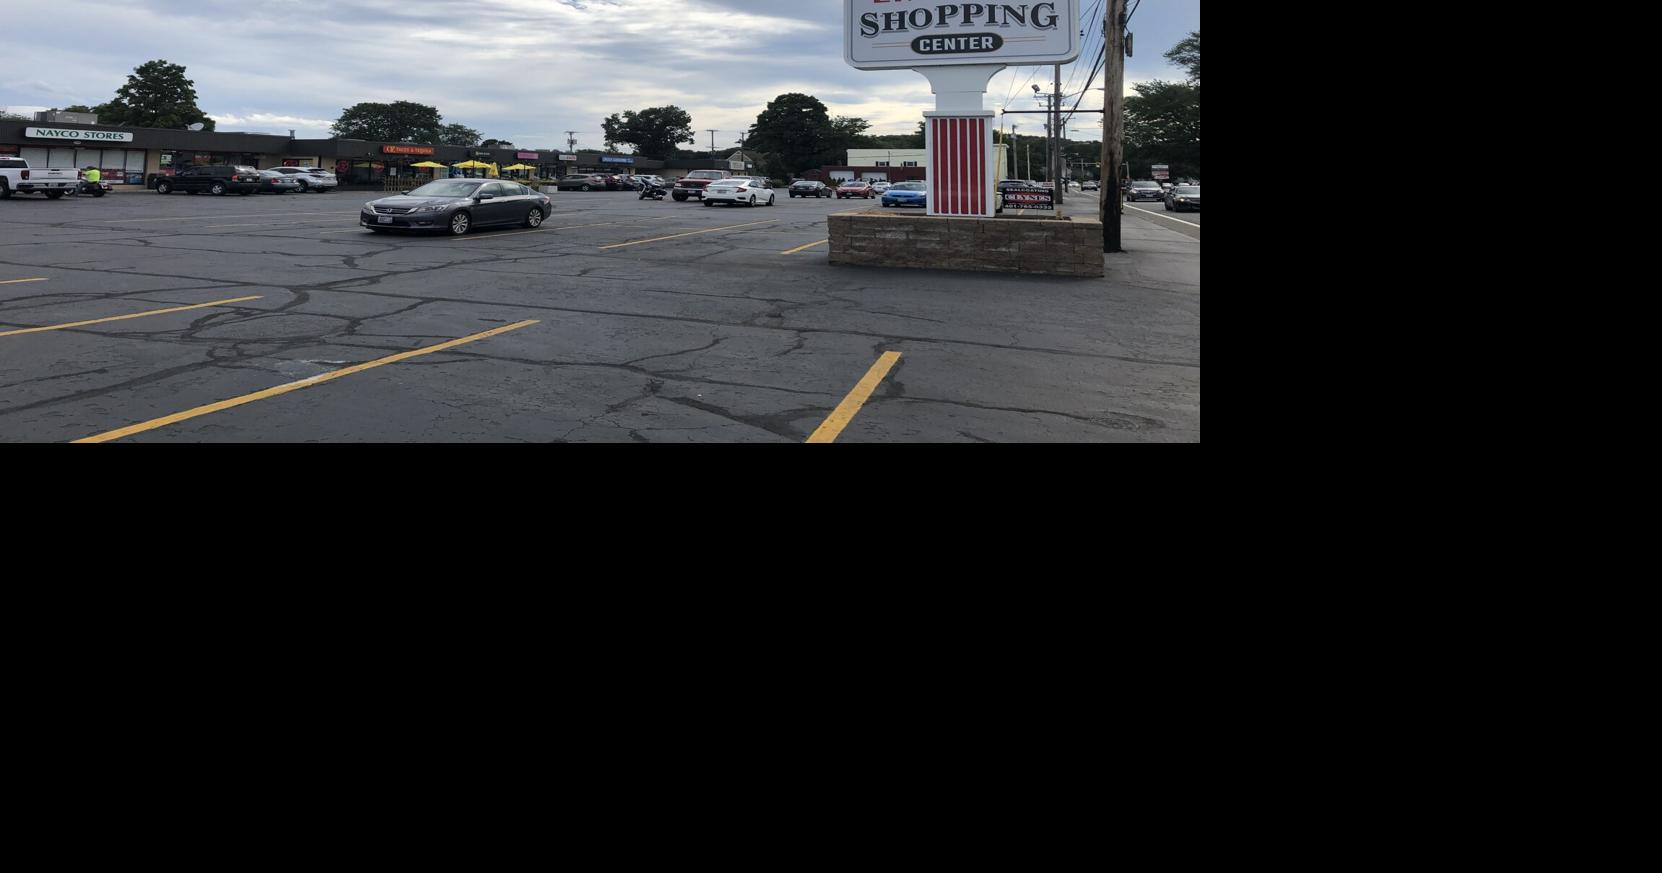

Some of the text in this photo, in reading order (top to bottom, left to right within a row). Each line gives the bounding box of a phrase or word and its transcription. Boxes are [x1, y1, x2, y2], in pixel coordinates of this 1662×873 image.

[860, 2, 1060, 38] SHOPPING
[919, 36, 994, 51] CENTER
[36, 129, 124, 140] NAYCO STORES
